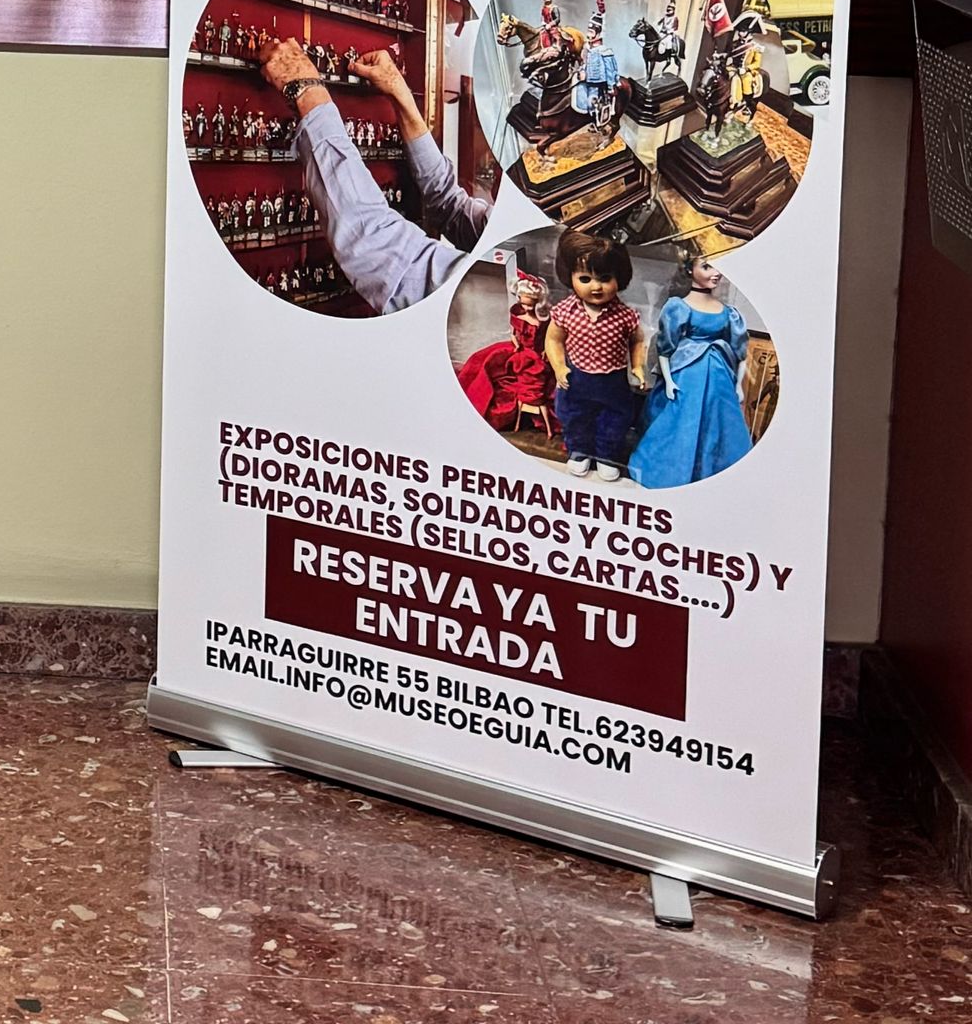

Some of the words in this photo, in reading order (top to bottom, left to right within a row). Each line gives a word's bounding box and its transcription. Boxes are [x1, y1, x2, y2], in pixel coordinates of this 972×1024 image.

[219, 446, 395, 511] (DIORAMAS,
[403, 488, 571, 544] SOLDADOS
[578, 524, 600, 550] Y
[607, 532, 760, 591] COCHES)
[770, 564, 793, 591] Y
[220, 422, 429, 483] EXPOSICIONES
[442, 465, 673, 534] PERMANENTES
[218, 479, 402, 538] TEMPORALES
[411, 515, 539, 573] (SELLOS,
[547, 550, 735, 619] CARTAS....)
[293, 538, 480, 615] RESERVA
[492, 584, 557, 632] YA
[578, 602, 637, 649] TU
[206, 620, 389, 684] IPARRAGUIRRE
[396, 664, 429, 693] 55
[436, 677, 534, 719] BILBAO
[542, 702, 755, 776] TEL.623949154
[355, 597, 564, 681] ENTRADA
[206, 647, 631, 775] EMAIL.INFO@MUSEOEGUIA.COM
